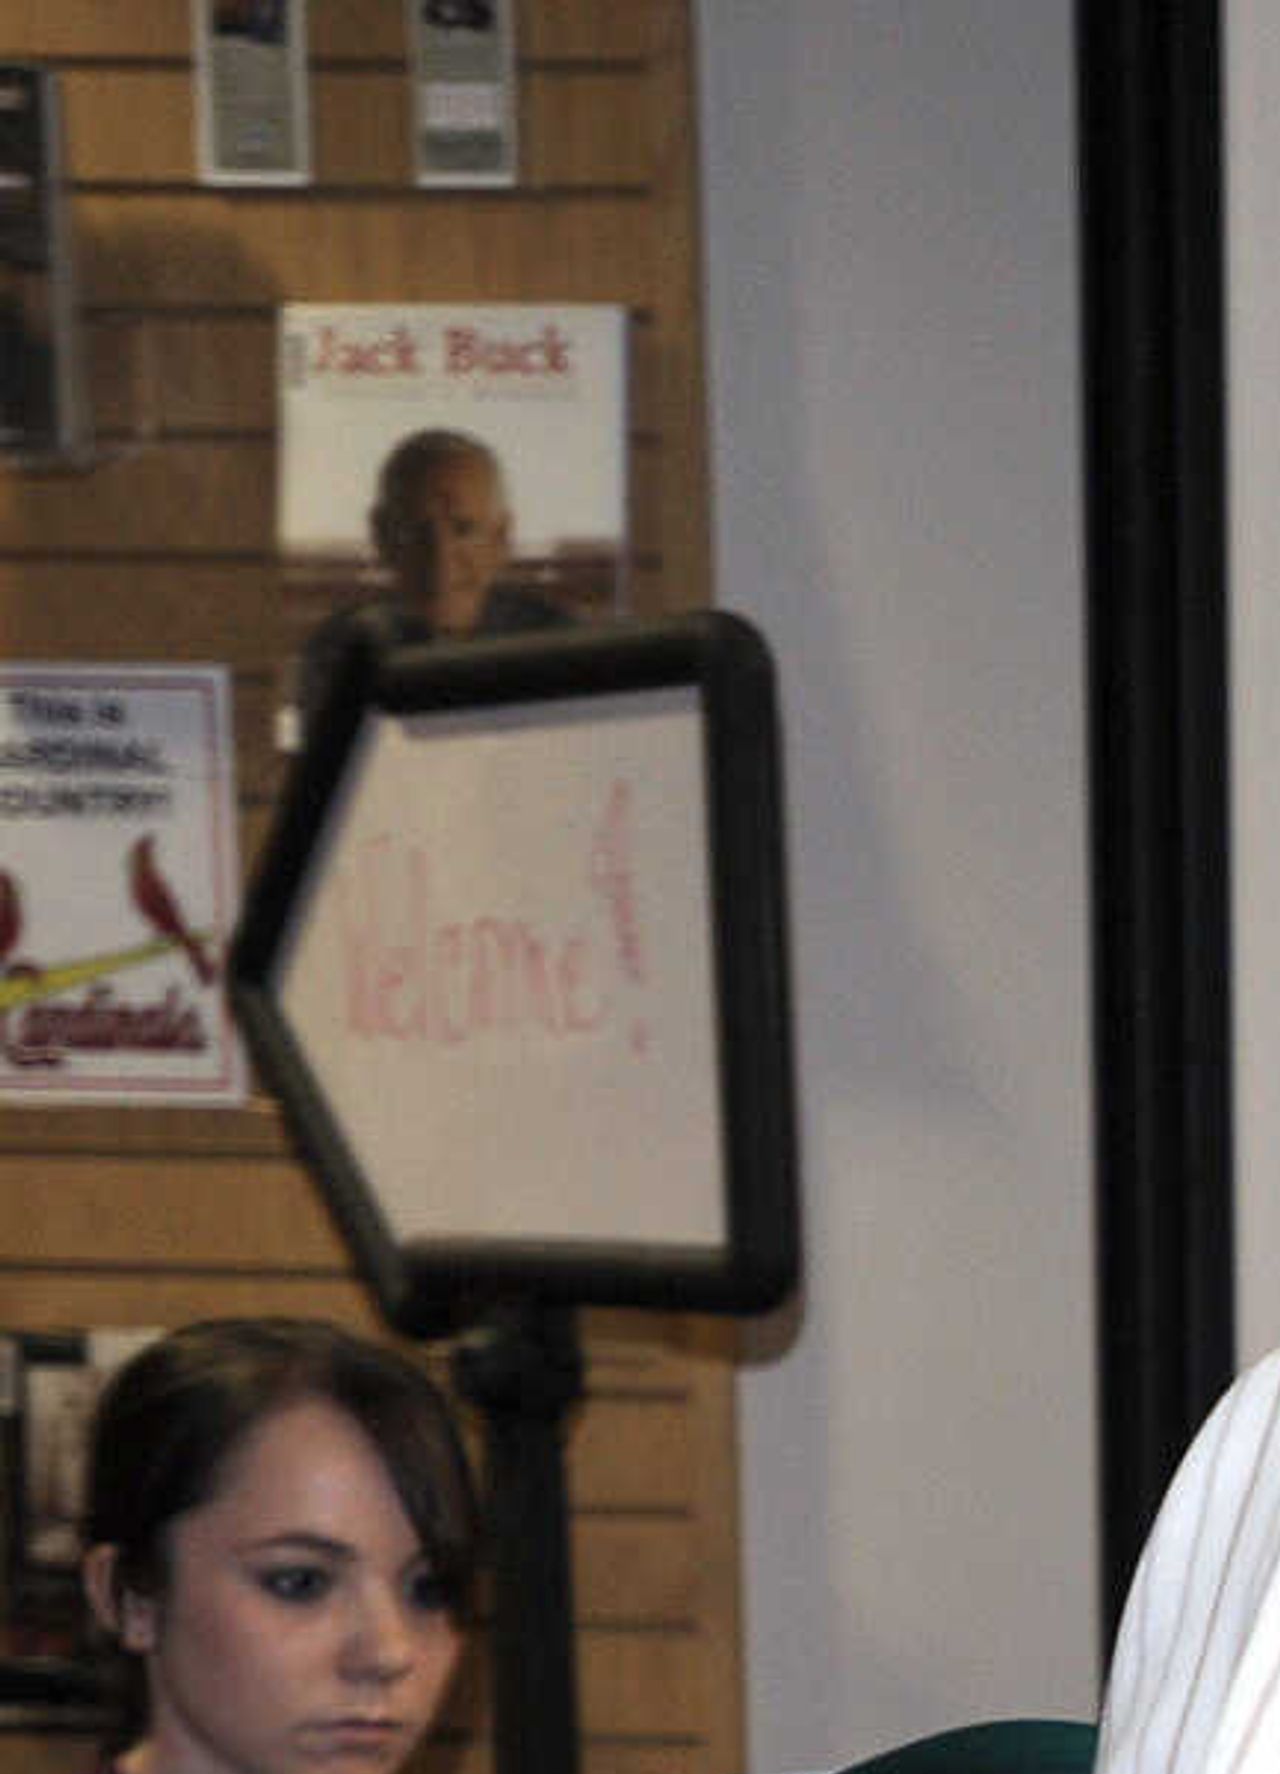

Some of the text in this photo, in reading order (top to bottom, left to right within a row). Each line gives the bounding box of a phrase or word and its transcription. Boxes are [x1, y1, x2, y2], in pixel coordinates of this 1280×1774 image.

[315, 325, 416, 376] Jack
[446, 325, 569, 376] Buck
[0, 735, 172, 775] ARDINAL
